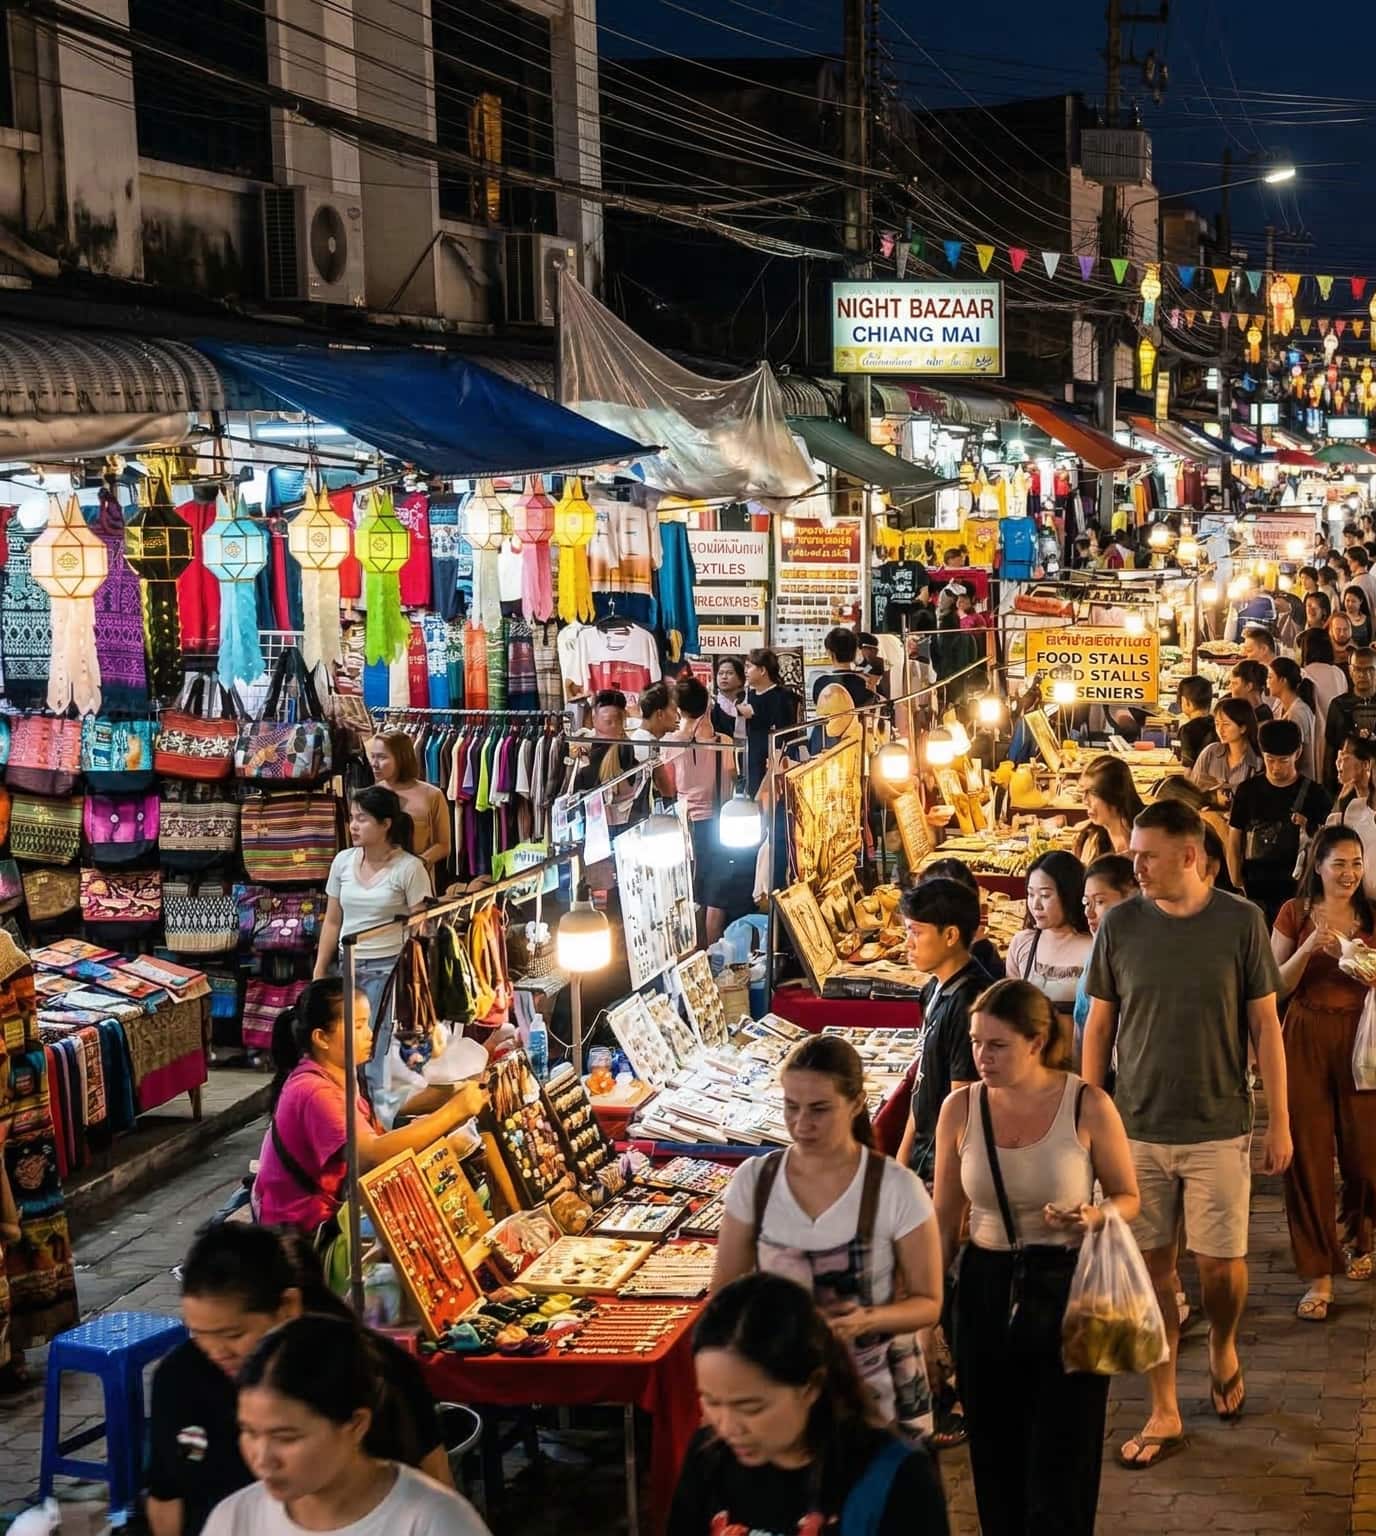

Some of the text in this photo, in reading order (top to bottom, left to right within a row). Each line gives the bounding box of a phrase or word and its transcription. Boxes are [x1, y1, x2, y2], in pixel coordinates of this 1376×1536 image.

[837, 298, 994, 318] NIGHT BAZAAR
[852, 326, 980, 343] CHIANG MAI
[1037, 652, 1149, 665] FOOD STALLS
[1090, 670, 1151, 682] STALLS
